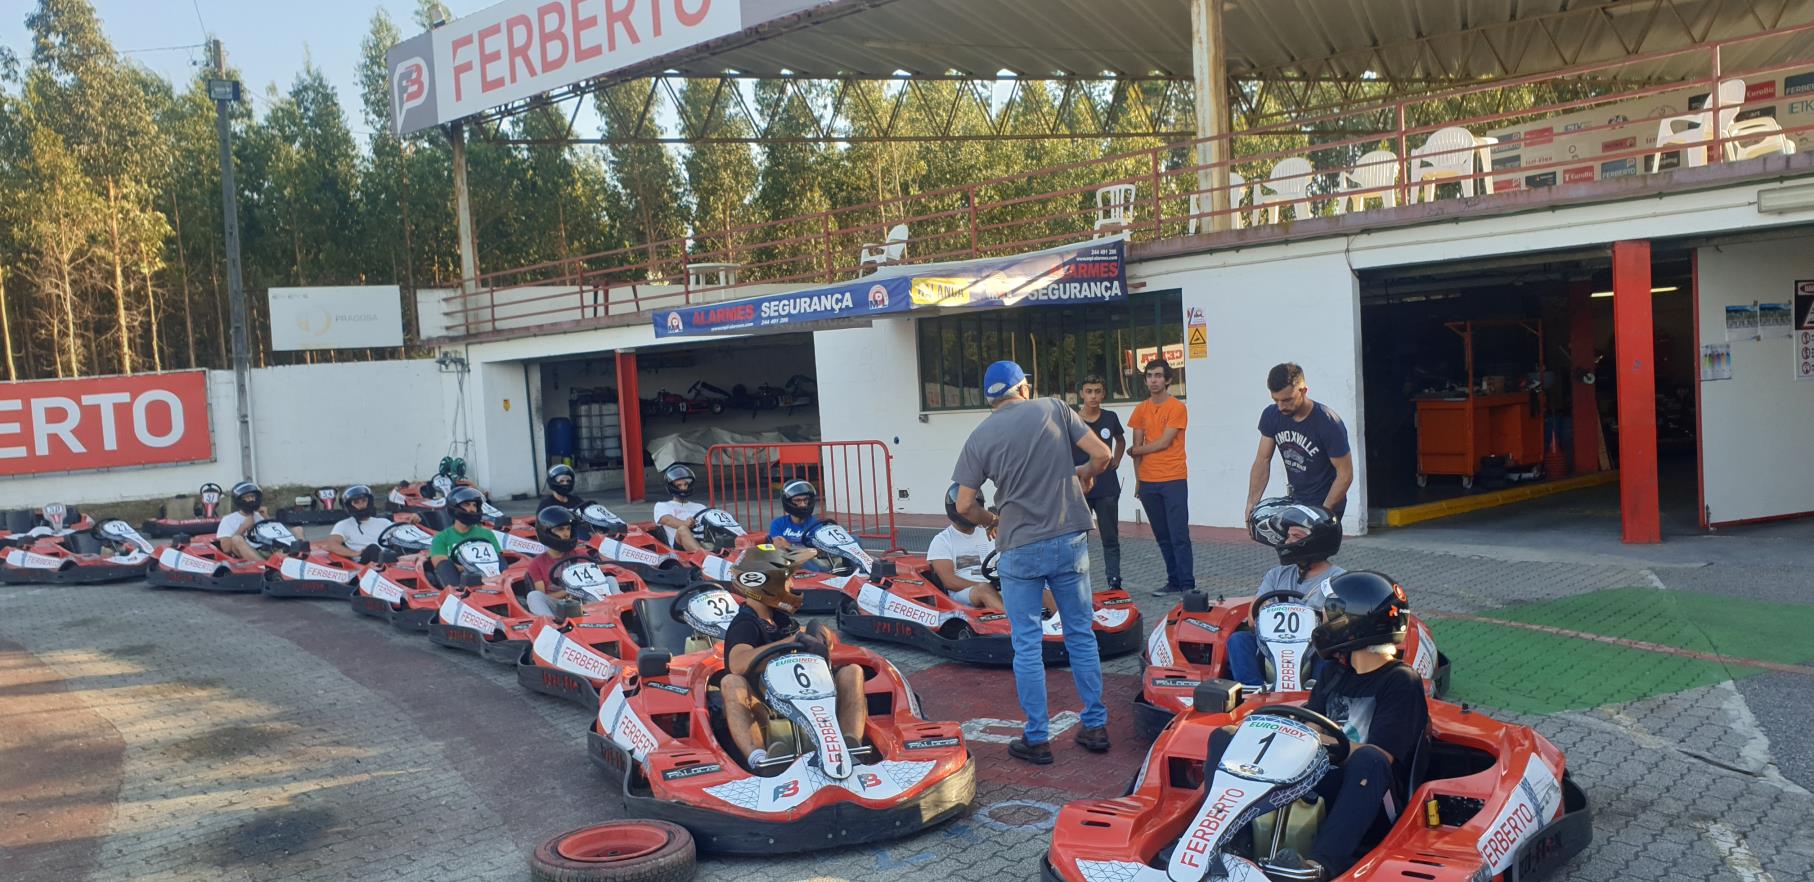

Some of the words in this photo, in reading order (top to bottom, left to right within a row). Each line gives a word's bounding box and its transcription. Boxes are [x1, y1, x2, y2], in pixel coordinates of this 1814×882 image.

[1028, 280, 1122, 301] SEGURANÇA
[692, 304, 755, 326] ALARMES
[761, 291, 854, 317] SEGURANÇA
[713, 511, 730, 523] 29
[828, 528, 847, 543] 15
[471, 546, 491, 559] 24
[621, 548, 658, 563] FERBERTO
[572, 566, 594, 582] 14
[707, 597, 735, 617] 32
[886, 601, 938, 626] FERBERTO
[1273, 611, 1300, 633] 20
[562, 646, 609, 678] FERBERTO
[775, 657, 820, 667] EUROINDY
[1281, 649, 1296, 693] ERBERTO
[793, 663, 811, 688] 6
[619, 715, 657, 756] FERBERT
[810, 705, 844, 764] FERBERTO
[1250, 721, 1308, 738] EUROINDY
[1253, 731, 1277, 765] 1
[1180, 788, 1245, 869] FERBERTO
[1481, 802, 1534, 868] ERBERTO
